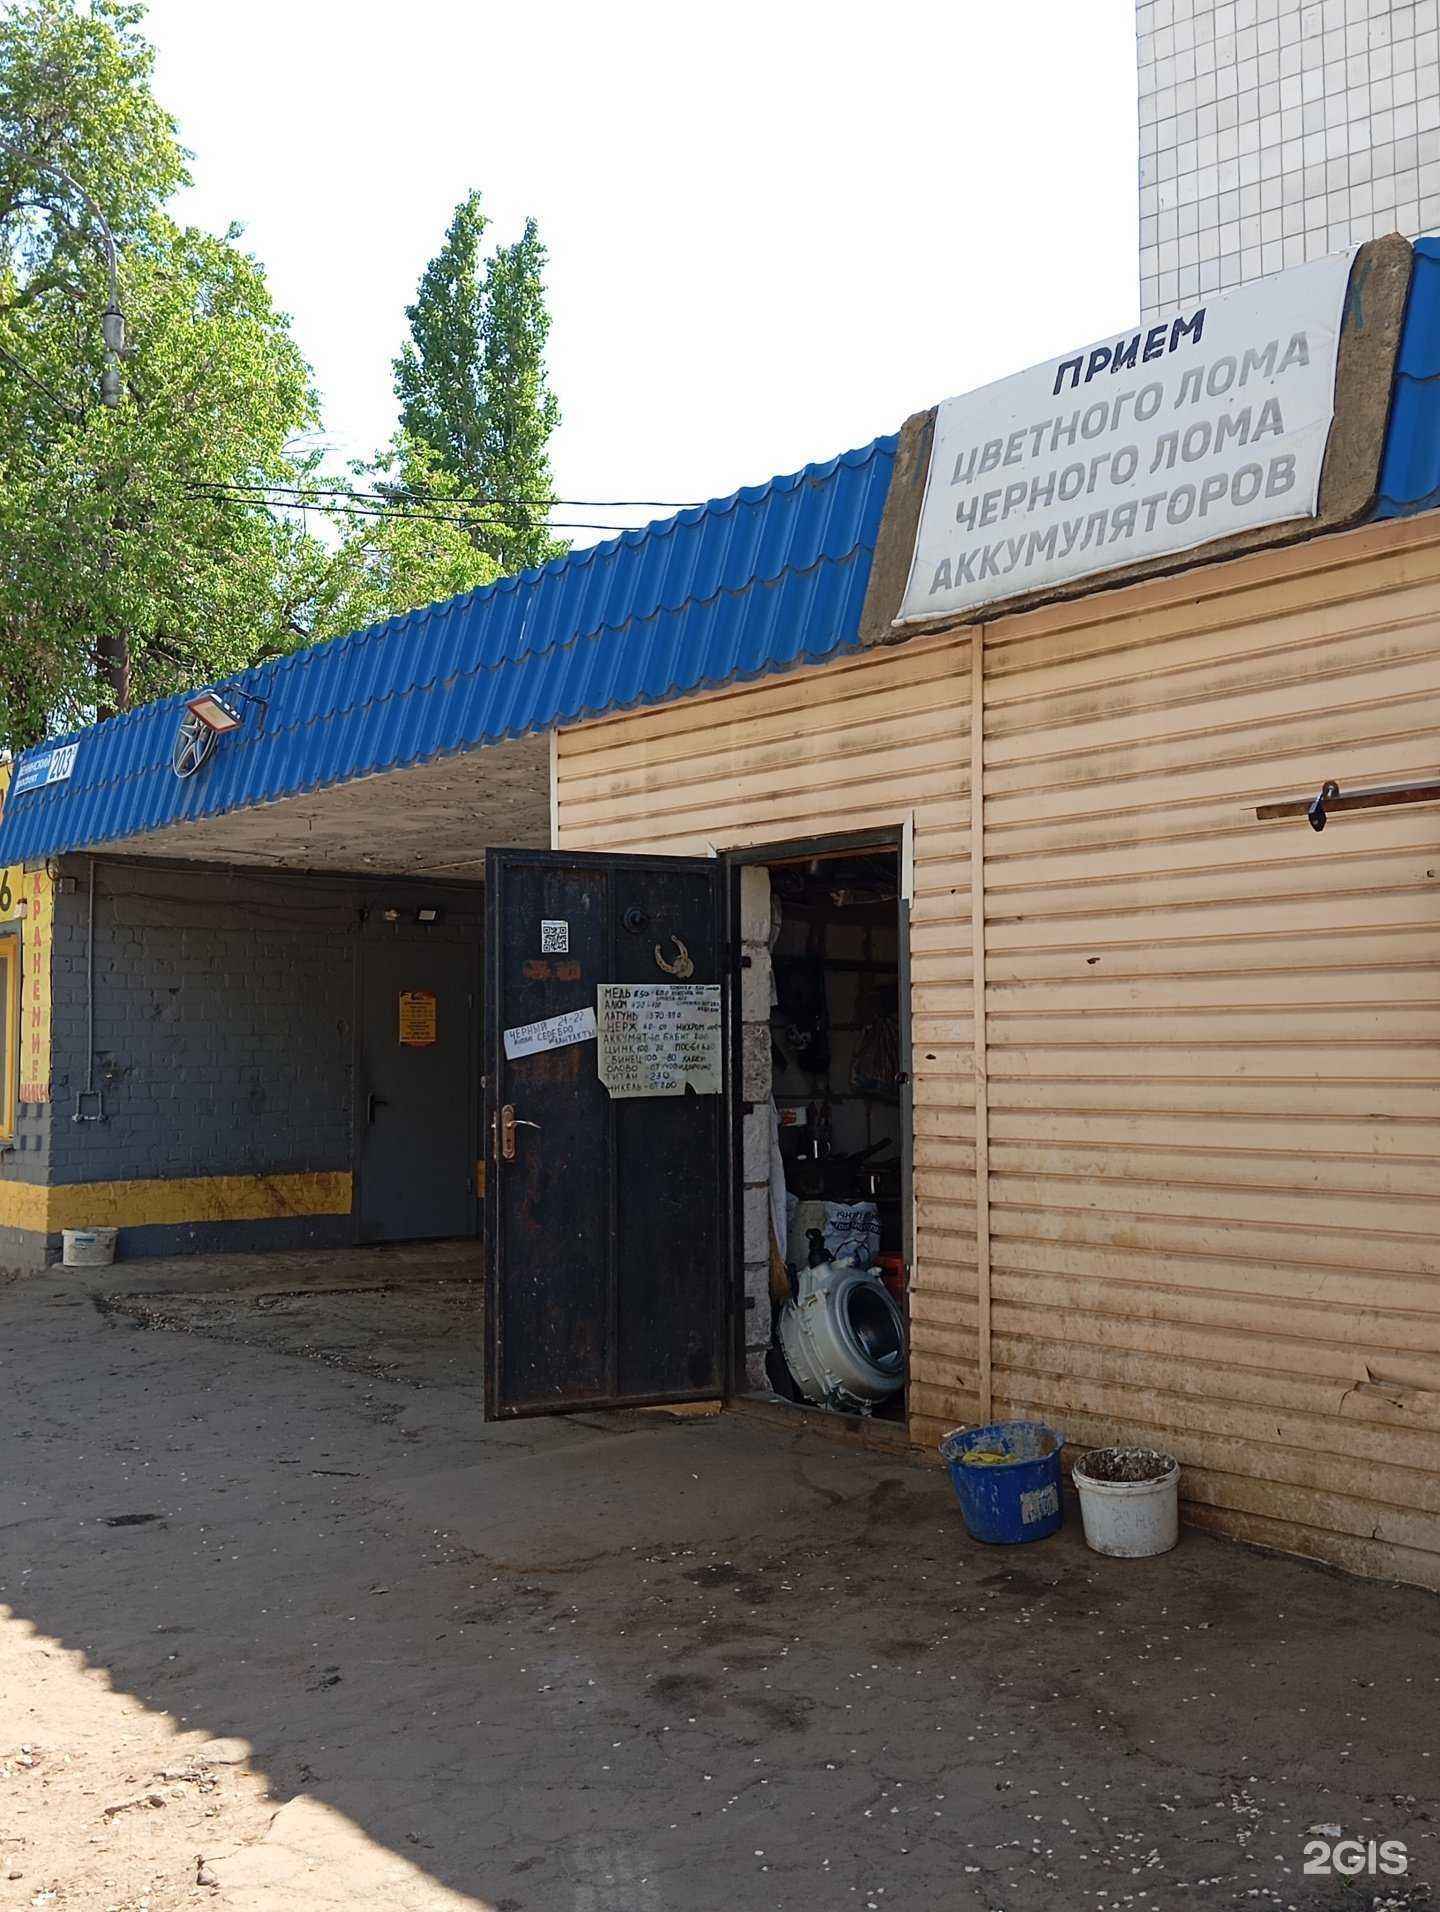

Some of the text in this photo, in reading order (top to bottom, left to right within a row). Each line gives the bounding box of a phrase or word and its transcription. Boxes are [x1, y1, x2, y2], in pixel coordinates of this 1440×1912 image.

[1053, 308, 1207, 395] ПРИЕМ
[950, 330, 1311, 488] ЦВЕТНОГО ЛОМА
[955, 397, 1286, 532] ЧЕРНОГО ЛОМА
[928, 453, 1297, 595] АККУМУЛЯТОРОВ
[32, 872, 42, 1081] ХРАНЕНИЕ
[604, 987, 631, 999] МЕДЬ
[604, 1010, 638, 1021] ЛАТУНЬ
[607, 1021, 638, 1033] НЕРЖ
